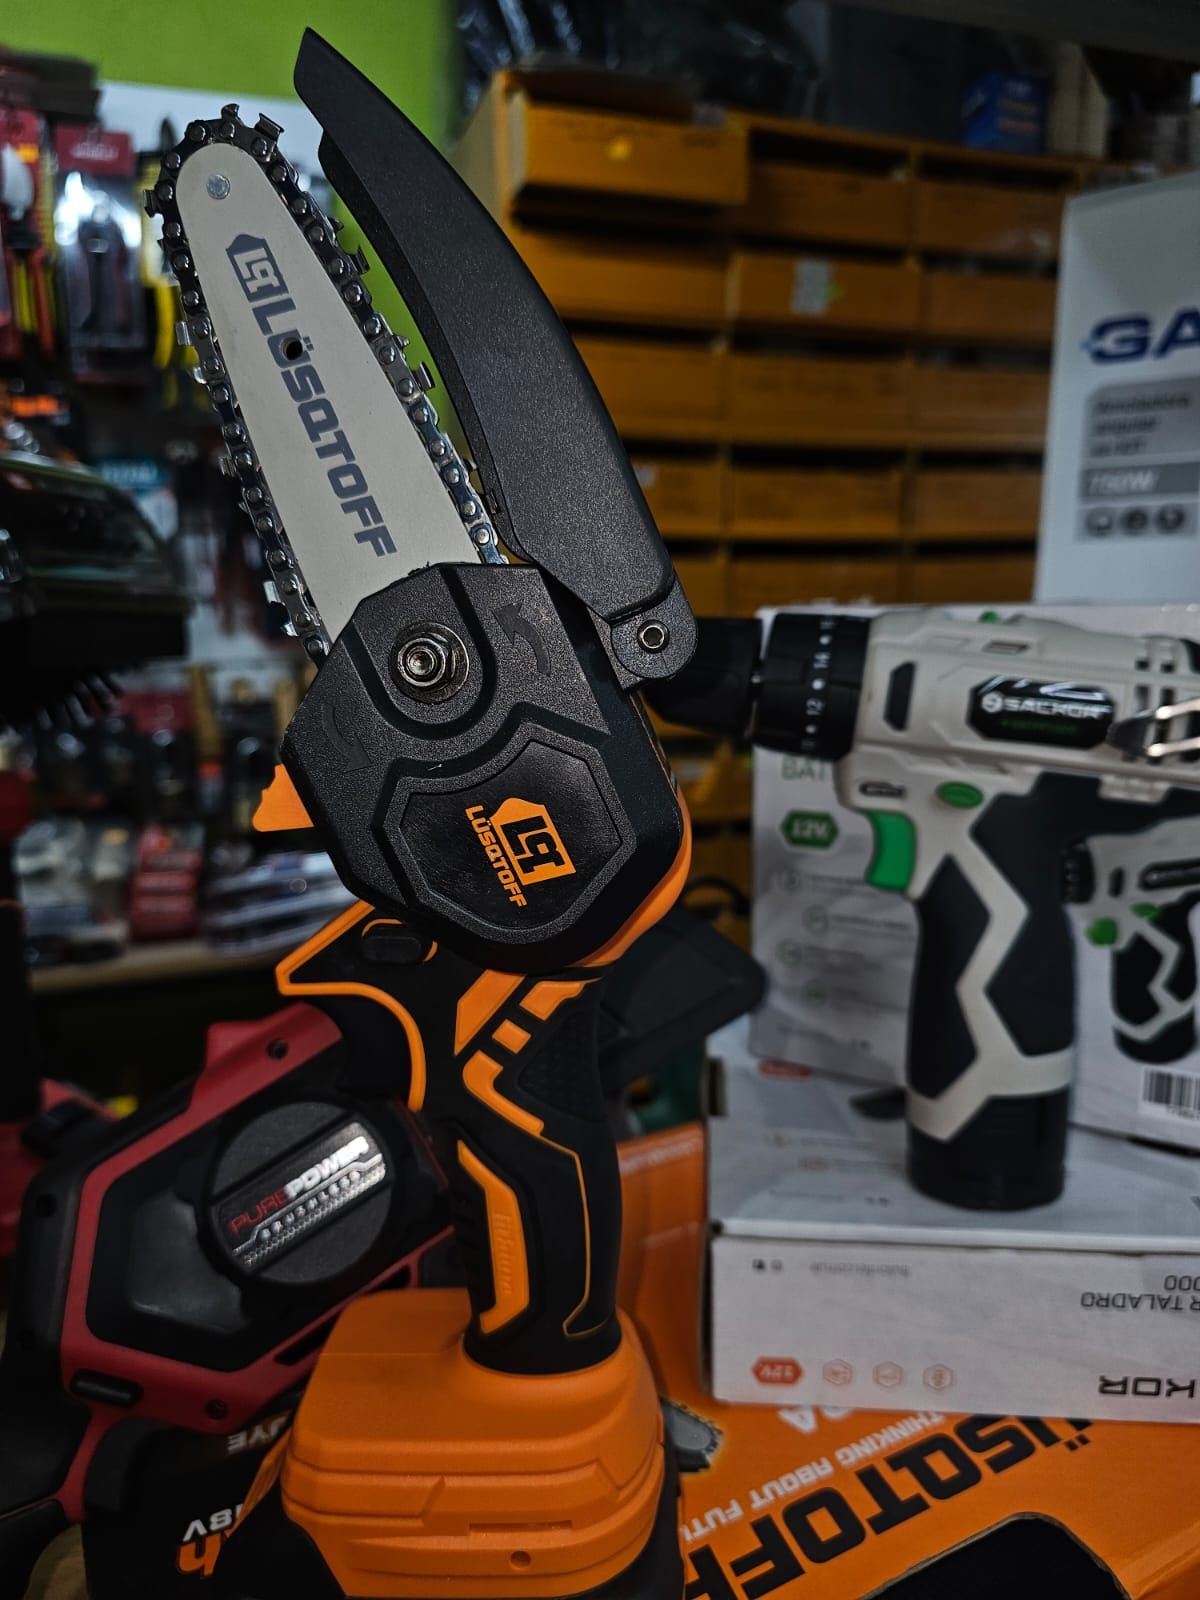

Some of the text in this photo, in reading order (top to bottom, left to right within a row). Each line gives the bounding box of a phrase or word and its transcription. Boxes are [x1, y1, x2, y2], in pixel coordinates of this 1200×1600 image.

[252, 298, 398, 558] LÜSQTOFF
[465, 804, 528, 907] LÜSQTOFF
[793, 819, 830, 840] 12V
[1080, 1291, 1184, 1311] TALADRO
[1098, 1375, 1196, 1399] KOR
[834, 1410, 946, 1468] THINKING
[749, 1457, 834, 1509] ABOUT
